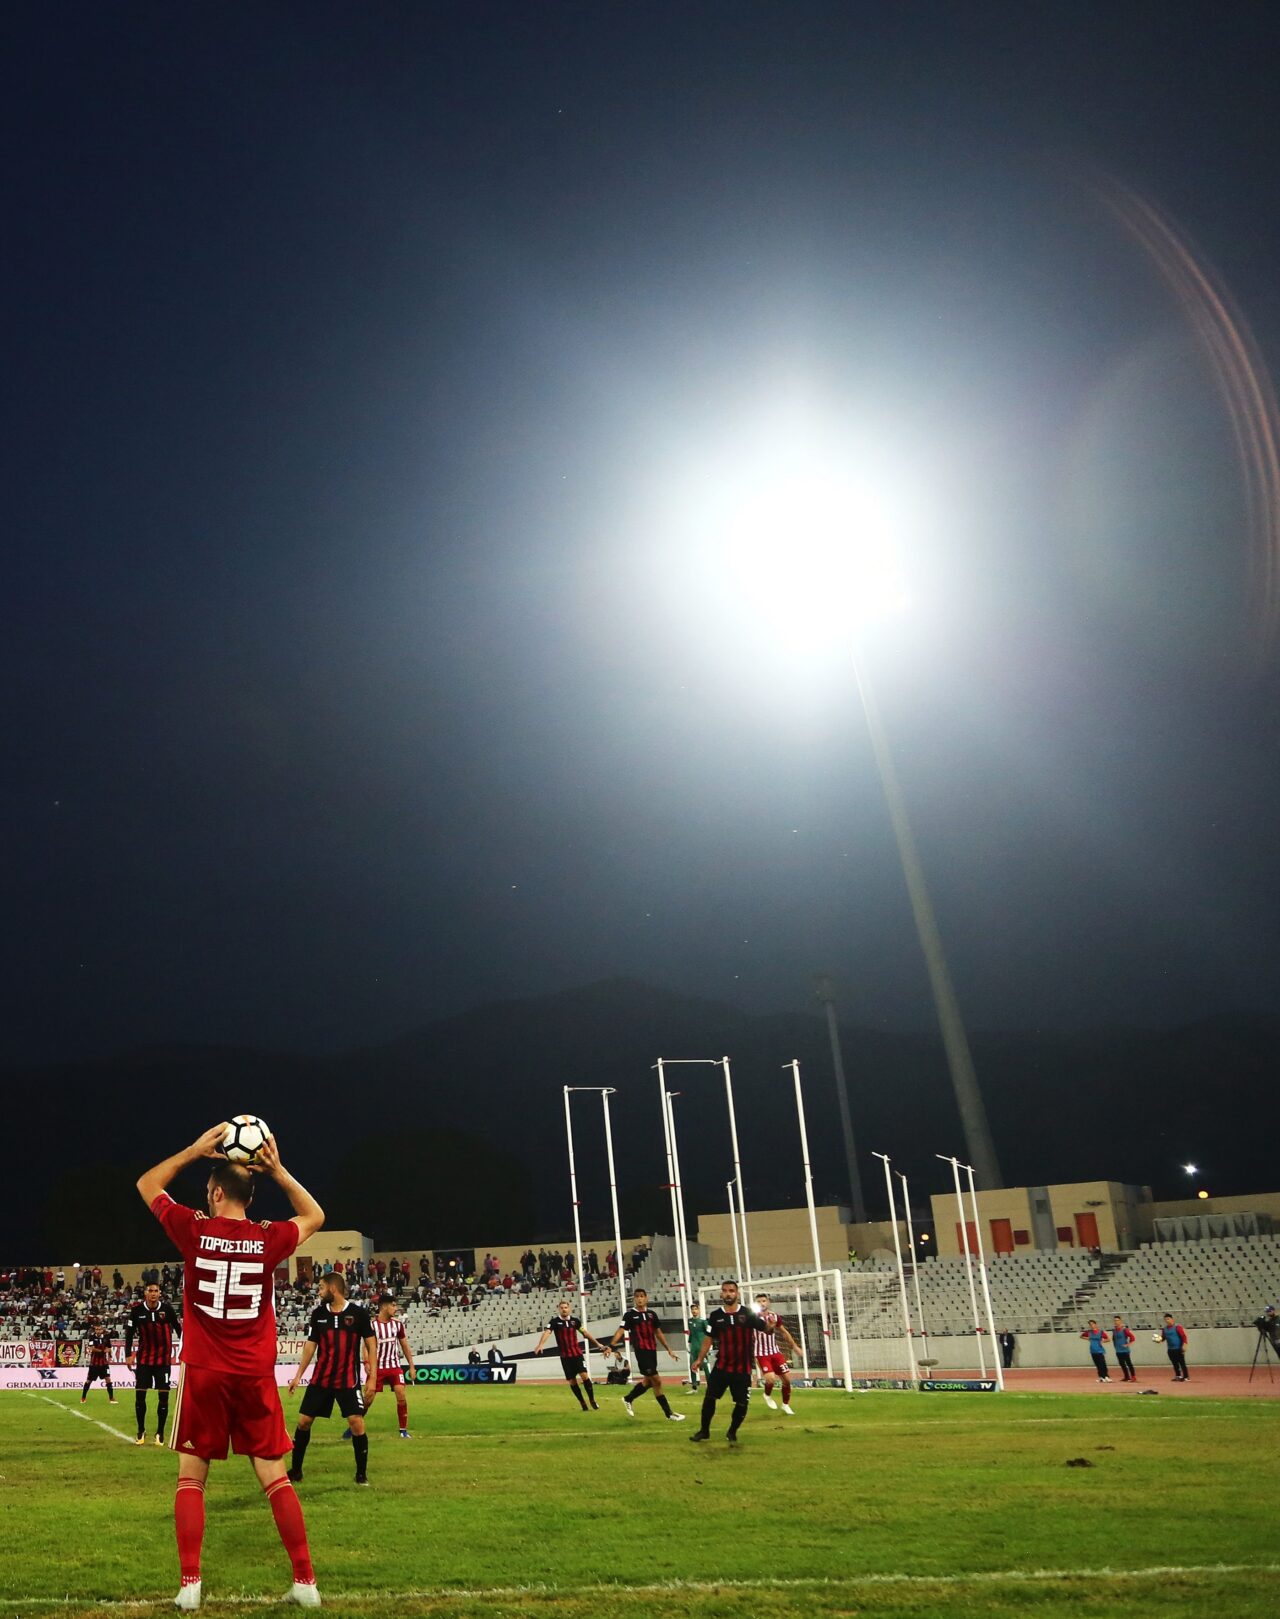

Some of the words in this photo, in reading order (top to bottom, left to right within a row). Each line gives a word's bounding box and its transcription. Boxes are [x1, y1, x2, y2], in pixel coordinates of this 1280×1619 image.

[193, 1256, 264, 1320] 35
[405, 1368, 489, 1382] COSMOTE
[490, 1367, 513, 1381] TV
